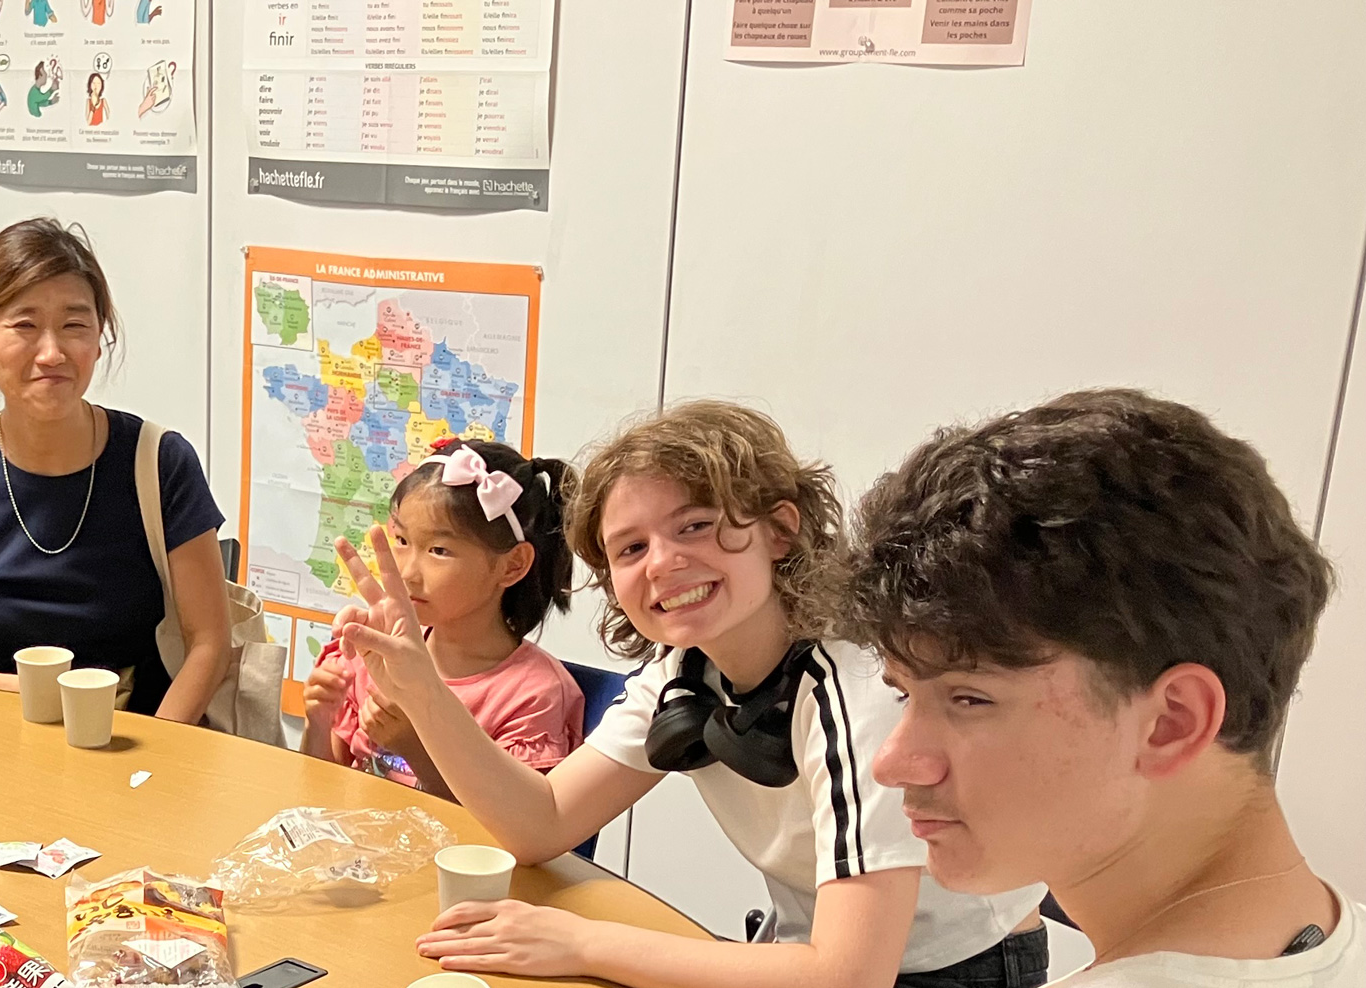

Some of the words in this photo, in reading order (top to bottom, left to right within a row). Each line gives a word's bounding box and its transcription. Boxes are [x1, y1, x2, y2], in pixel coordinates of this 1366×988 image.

[279, 13, 286, 25] ir
[270, 32, 294, 45] finir
[819, 49, 916, 57] www.groupement-fle.com
[259, 168, 324, 188] hachettefle.fr
[316, 264, 326, 274] LA
[328, 265, 360, 277] FRANCE
[363, 269, 444, 283] ADMINISTRATIVE
